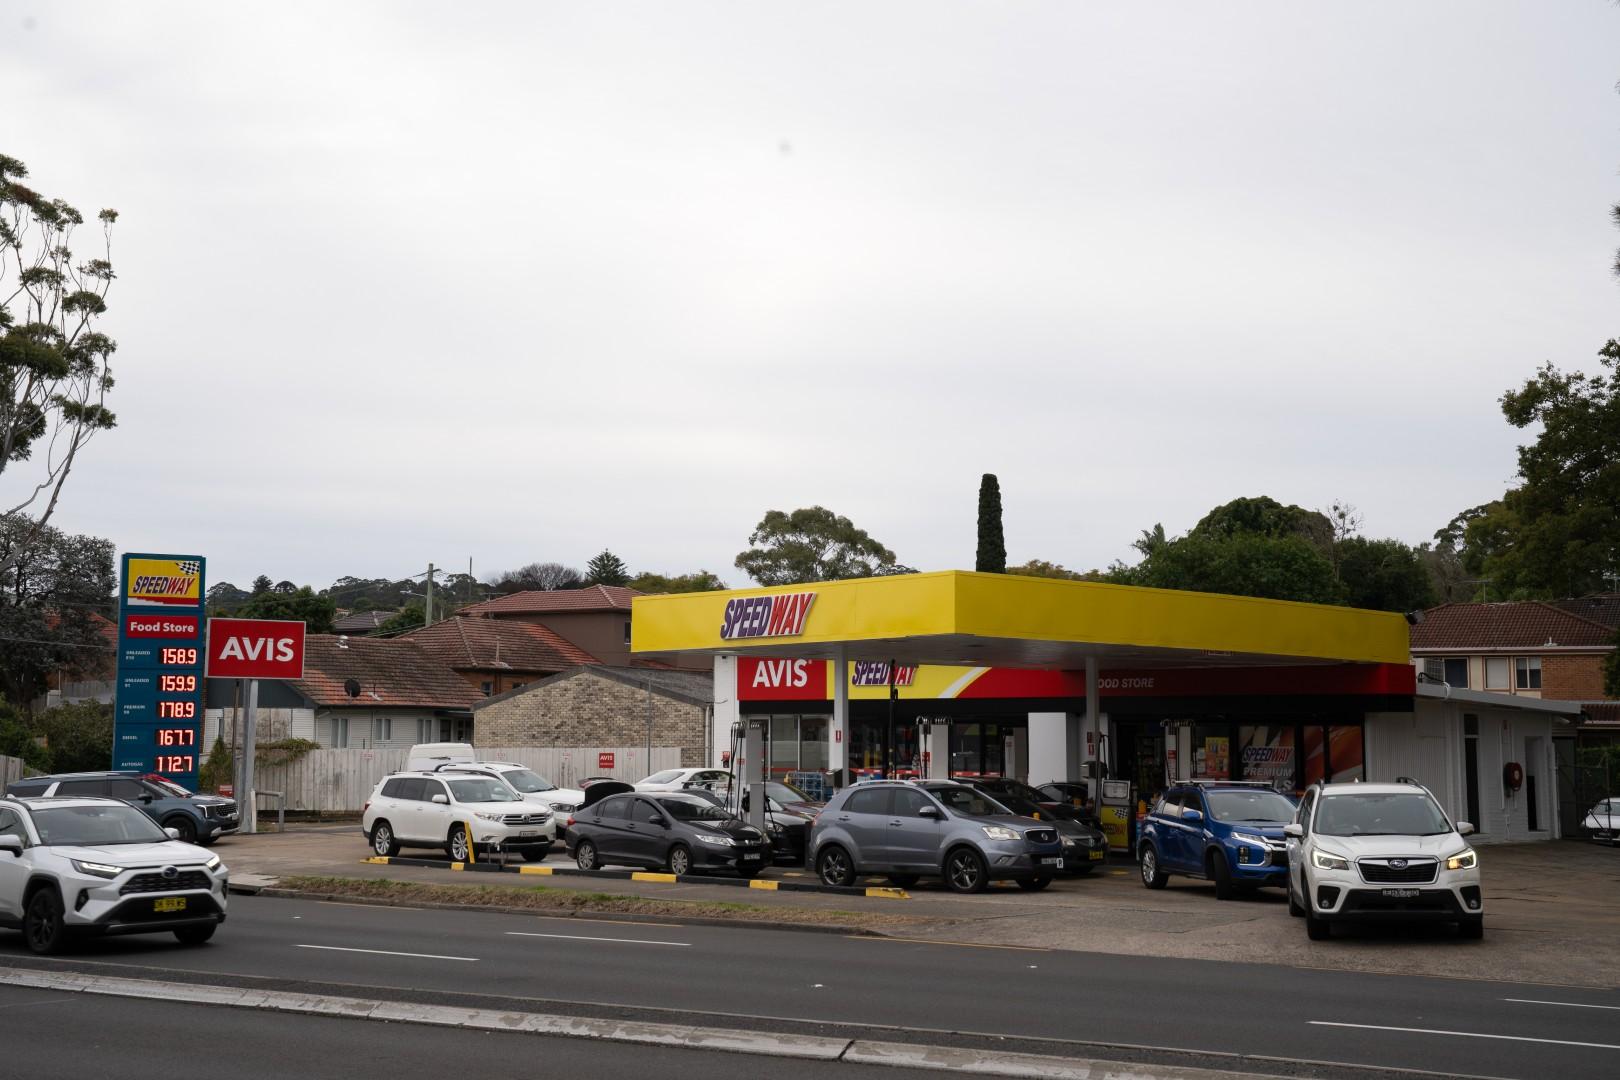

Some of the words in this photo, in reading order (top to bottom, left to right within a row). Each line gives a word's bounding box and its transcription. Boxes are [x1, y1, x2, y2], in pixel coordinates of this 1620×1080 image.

[133, 575, 195, 595] SPEEDWAY
[720, 594, 815, 639] SPEEDWAY
[130, 621, 160, 632] Food
[163, 622, 195, 633] Store
[163, 648, 197, 664] 158.9
[218, 637, 295, 662] AVIS
[752, 659, 808, 688] AVIS
[162, 675, 196, 692] 159.9
[1098, 678, 1119, 689] OOD
[1121, 677, 1155, 688] STORE
[160, 702, 195, 718] 178.9
[159, 729, 194, 746] 167.7
[1242, 746, 1294, 763] SPEEDWAY
[158, 756, 193, 772] 112.7
[1243, 767, 1292, 777] PREMIUM
